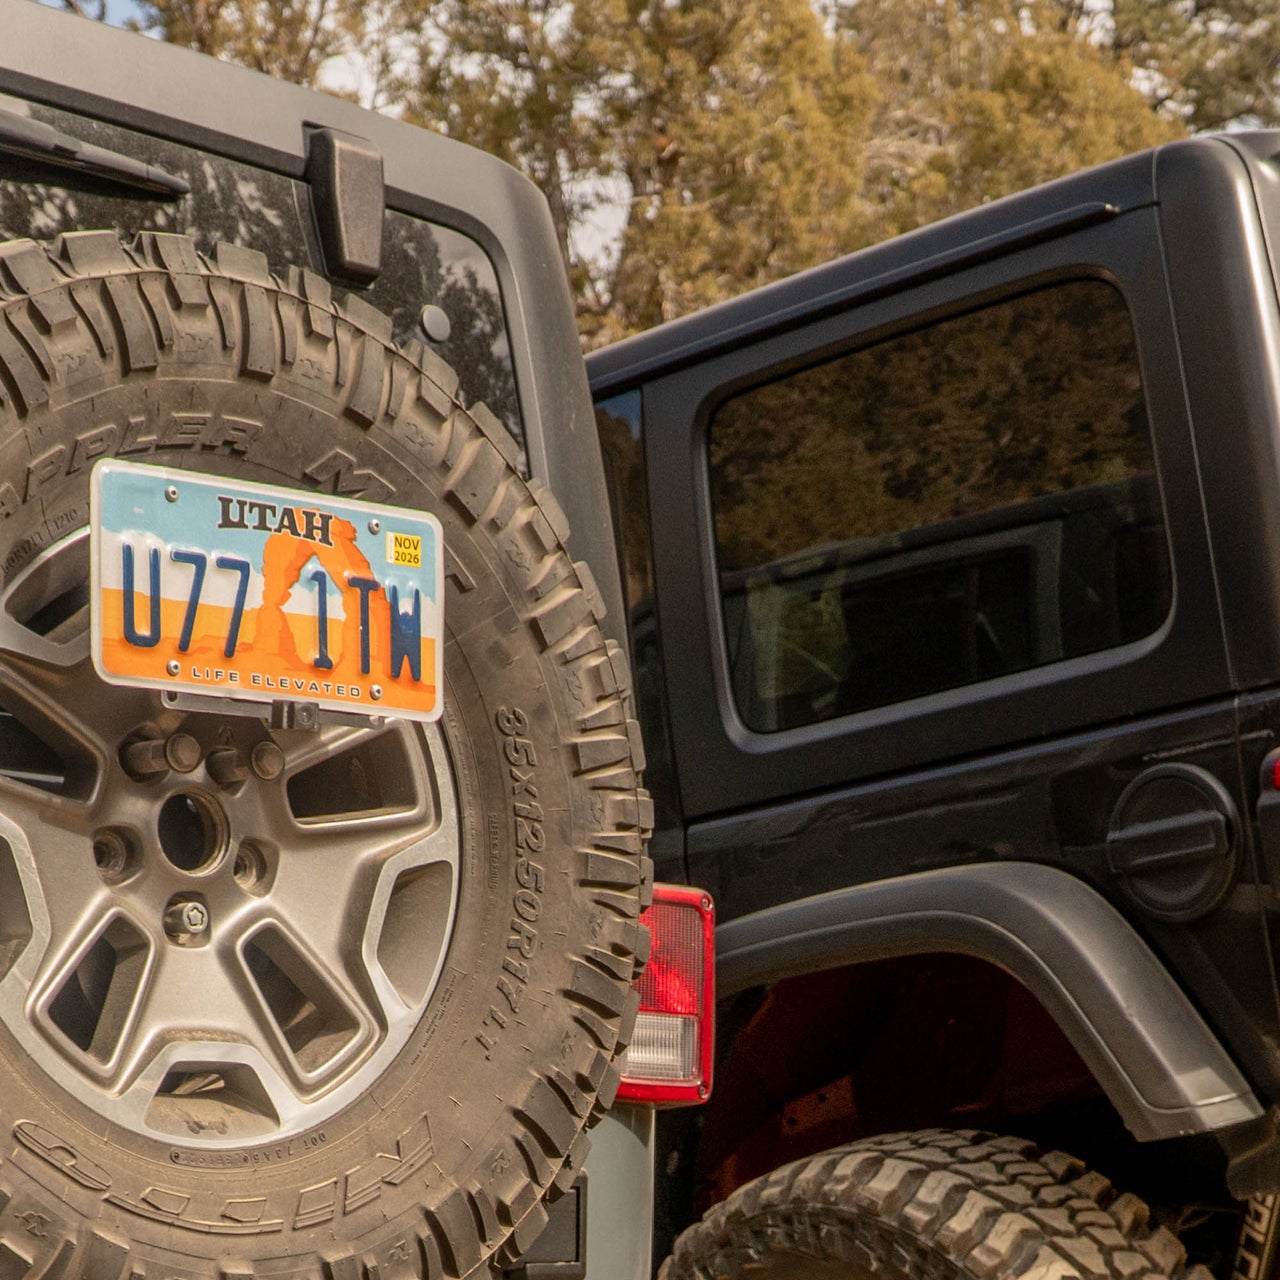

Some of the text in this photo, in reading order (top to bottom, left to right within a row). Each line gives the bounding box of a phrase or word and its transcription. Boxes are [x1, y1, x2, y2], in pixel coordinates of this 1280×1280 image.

[218, 496, 334, 547] UTAH
[394, 536, 420, 551] NOV
[394, 550, 420, 565] 2026
[192, 667, 362, 699] LIFE ELEVATED
[12, 1112, 434, 1233] NITTO
